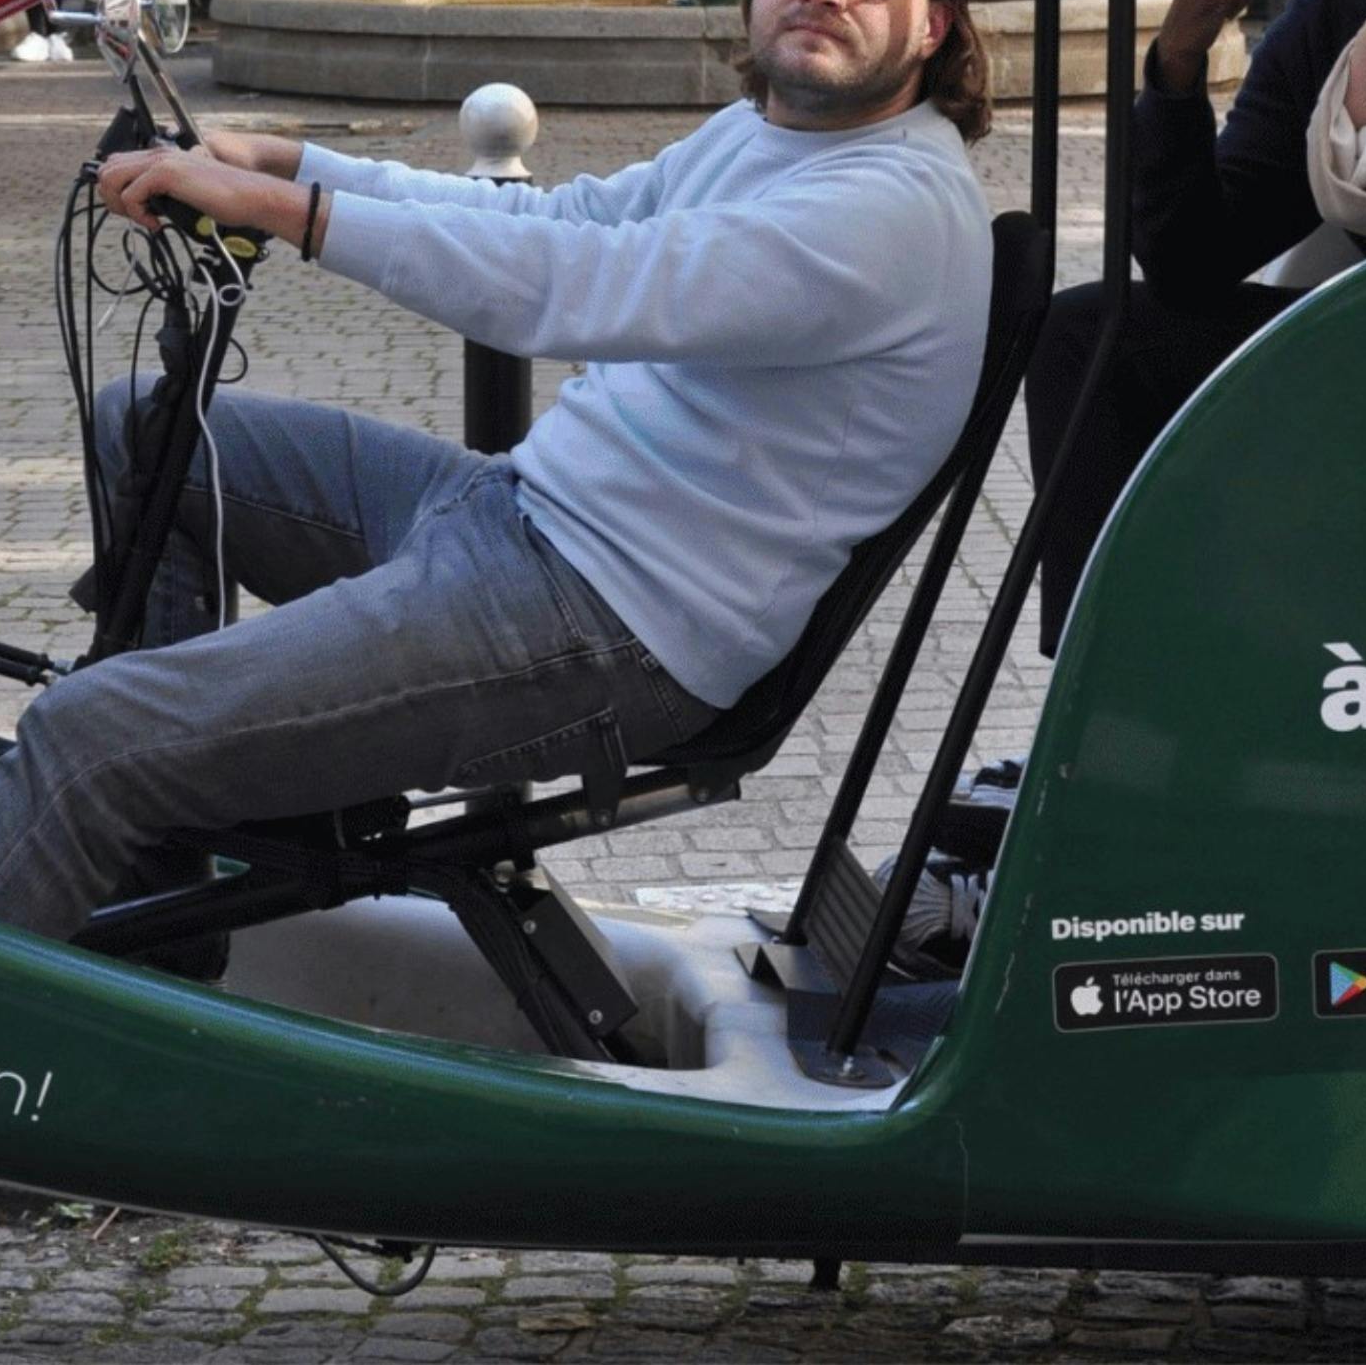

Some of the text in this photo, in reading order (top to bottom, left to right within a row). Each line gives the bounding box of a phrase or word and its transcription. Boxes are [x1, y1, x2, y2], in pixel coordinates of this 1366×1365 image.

[1051, 910, 1246, 942] Disponible sur
[1112, 969, 1241, 986] Télécharger dans
[1114, 985, 1262, 1017] l'App Store
